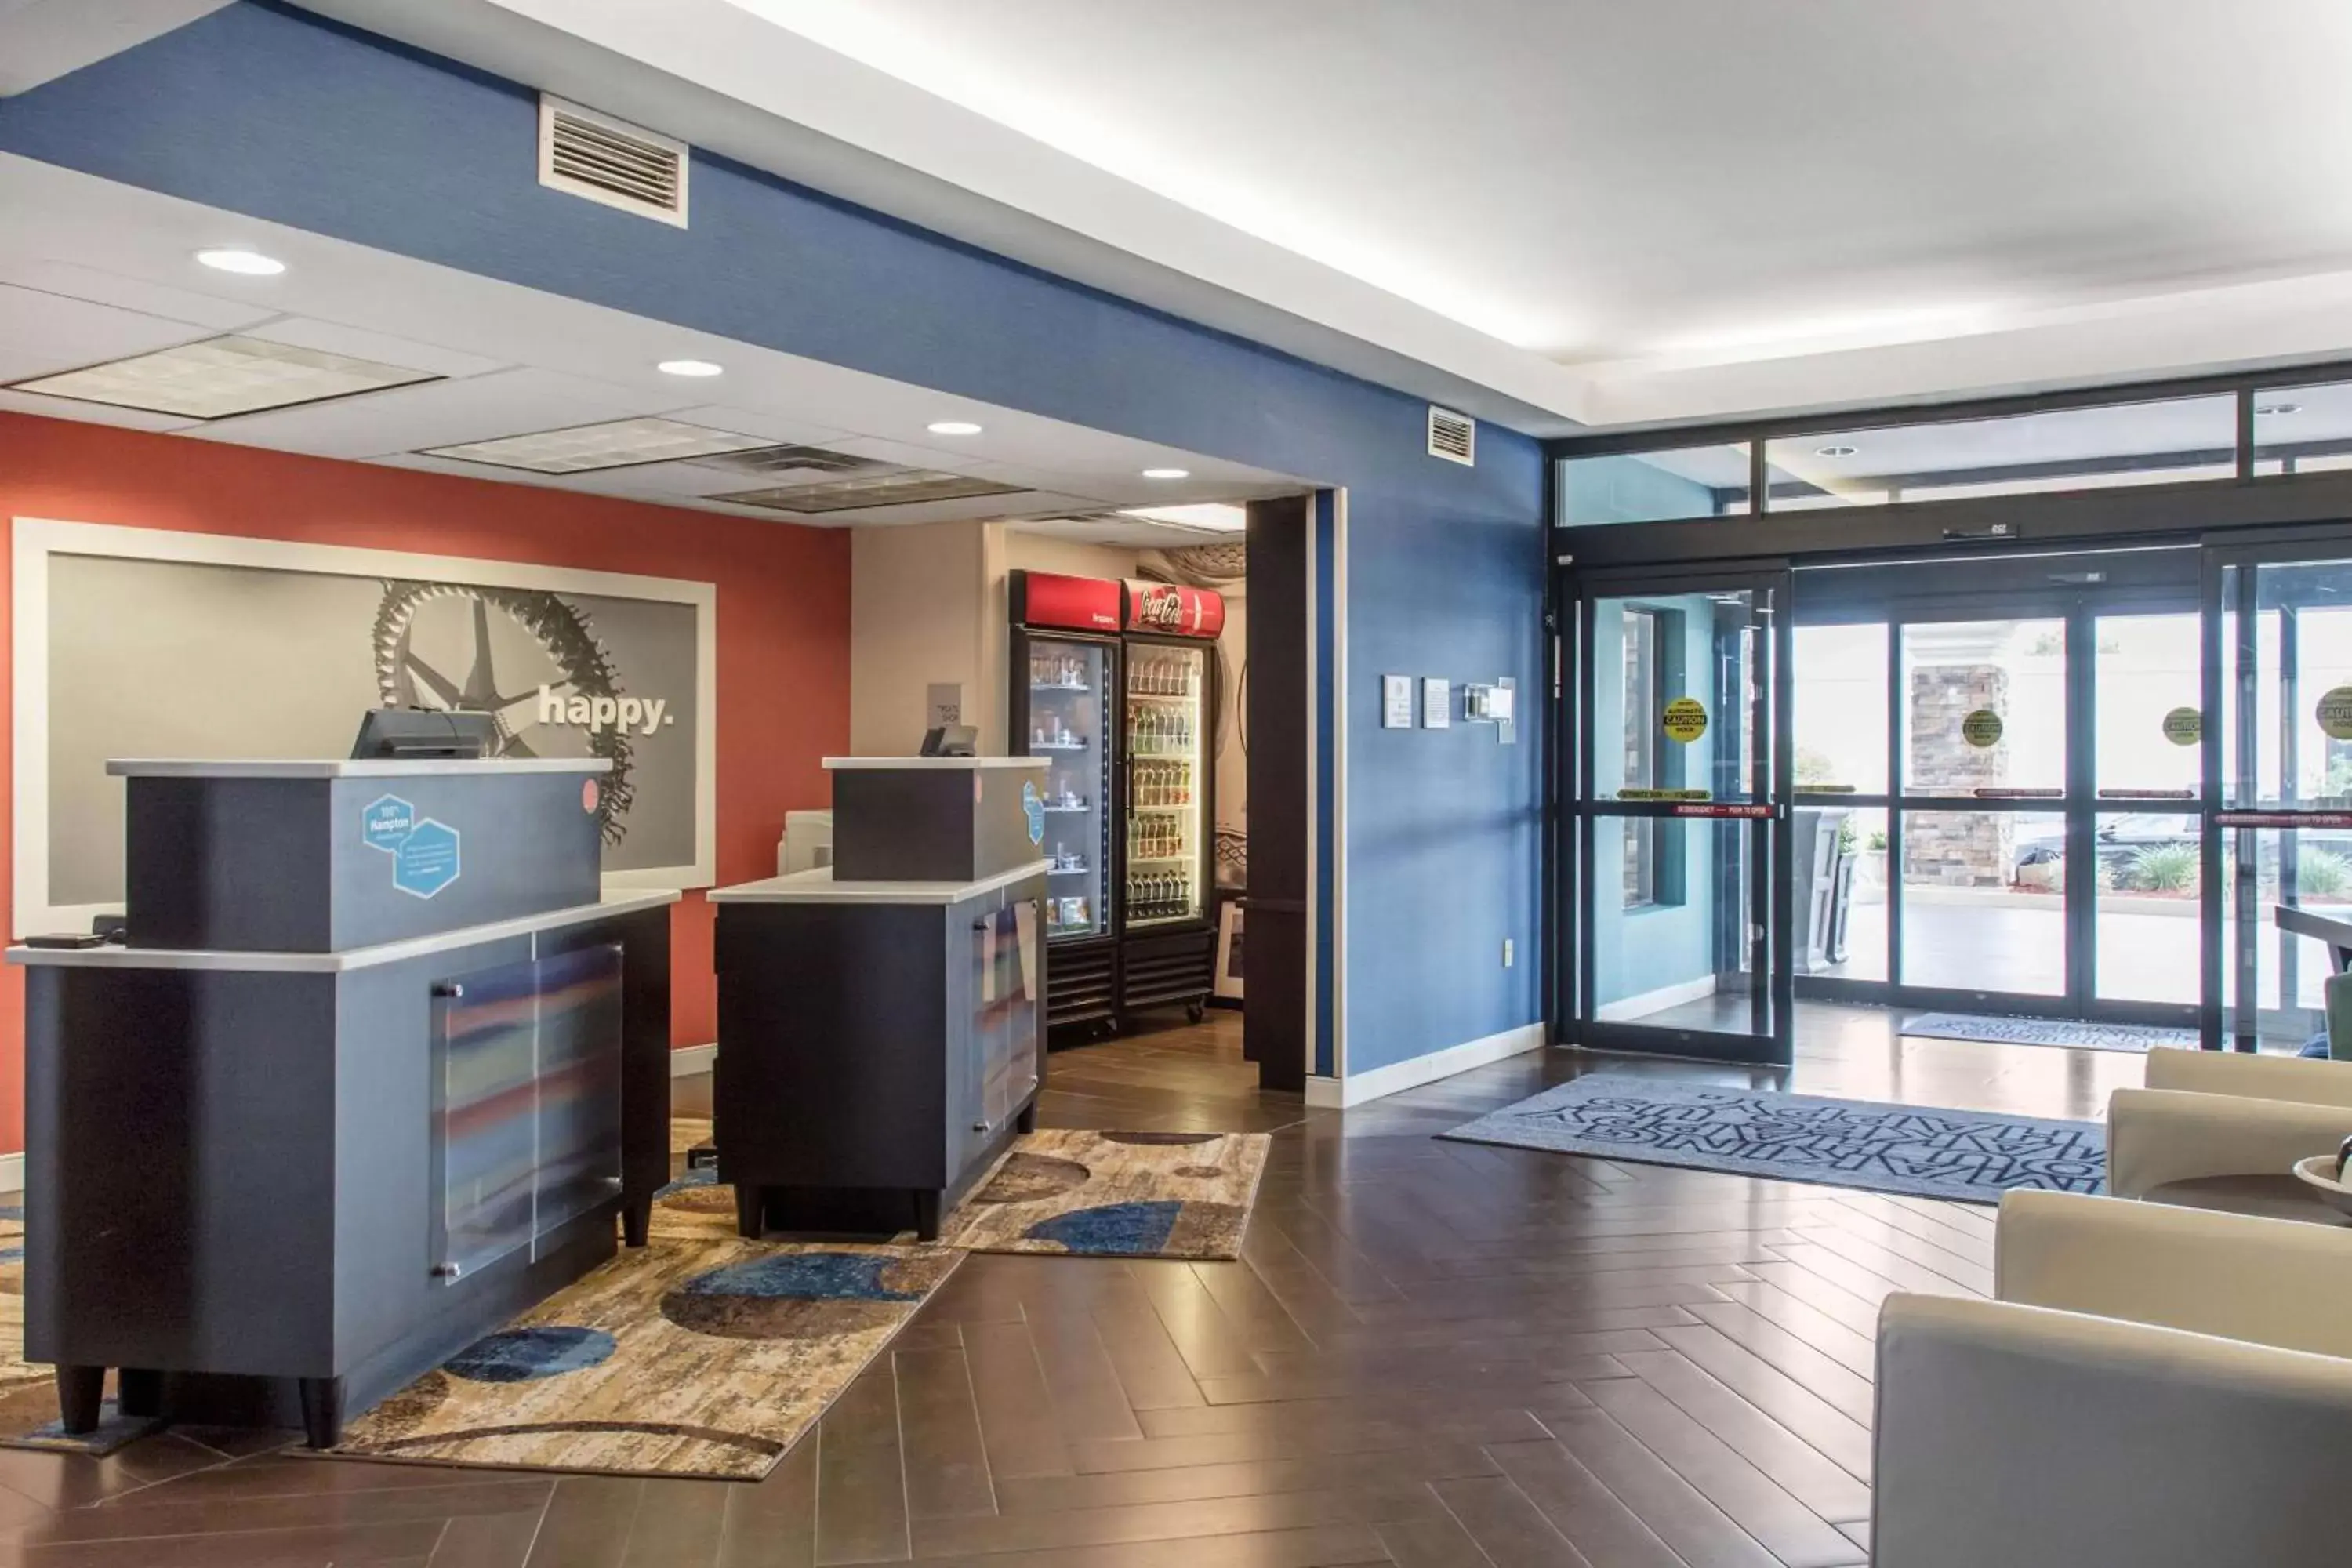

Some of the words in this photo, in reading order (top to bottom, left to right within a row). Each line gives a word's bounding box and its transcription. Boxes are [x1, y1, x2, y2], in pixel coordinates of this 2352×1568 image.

[539, 684, 673, 735] happy.
[1666, 715, 1705, 725] CAUTION
[370, 818, 409, 833] Hampton
